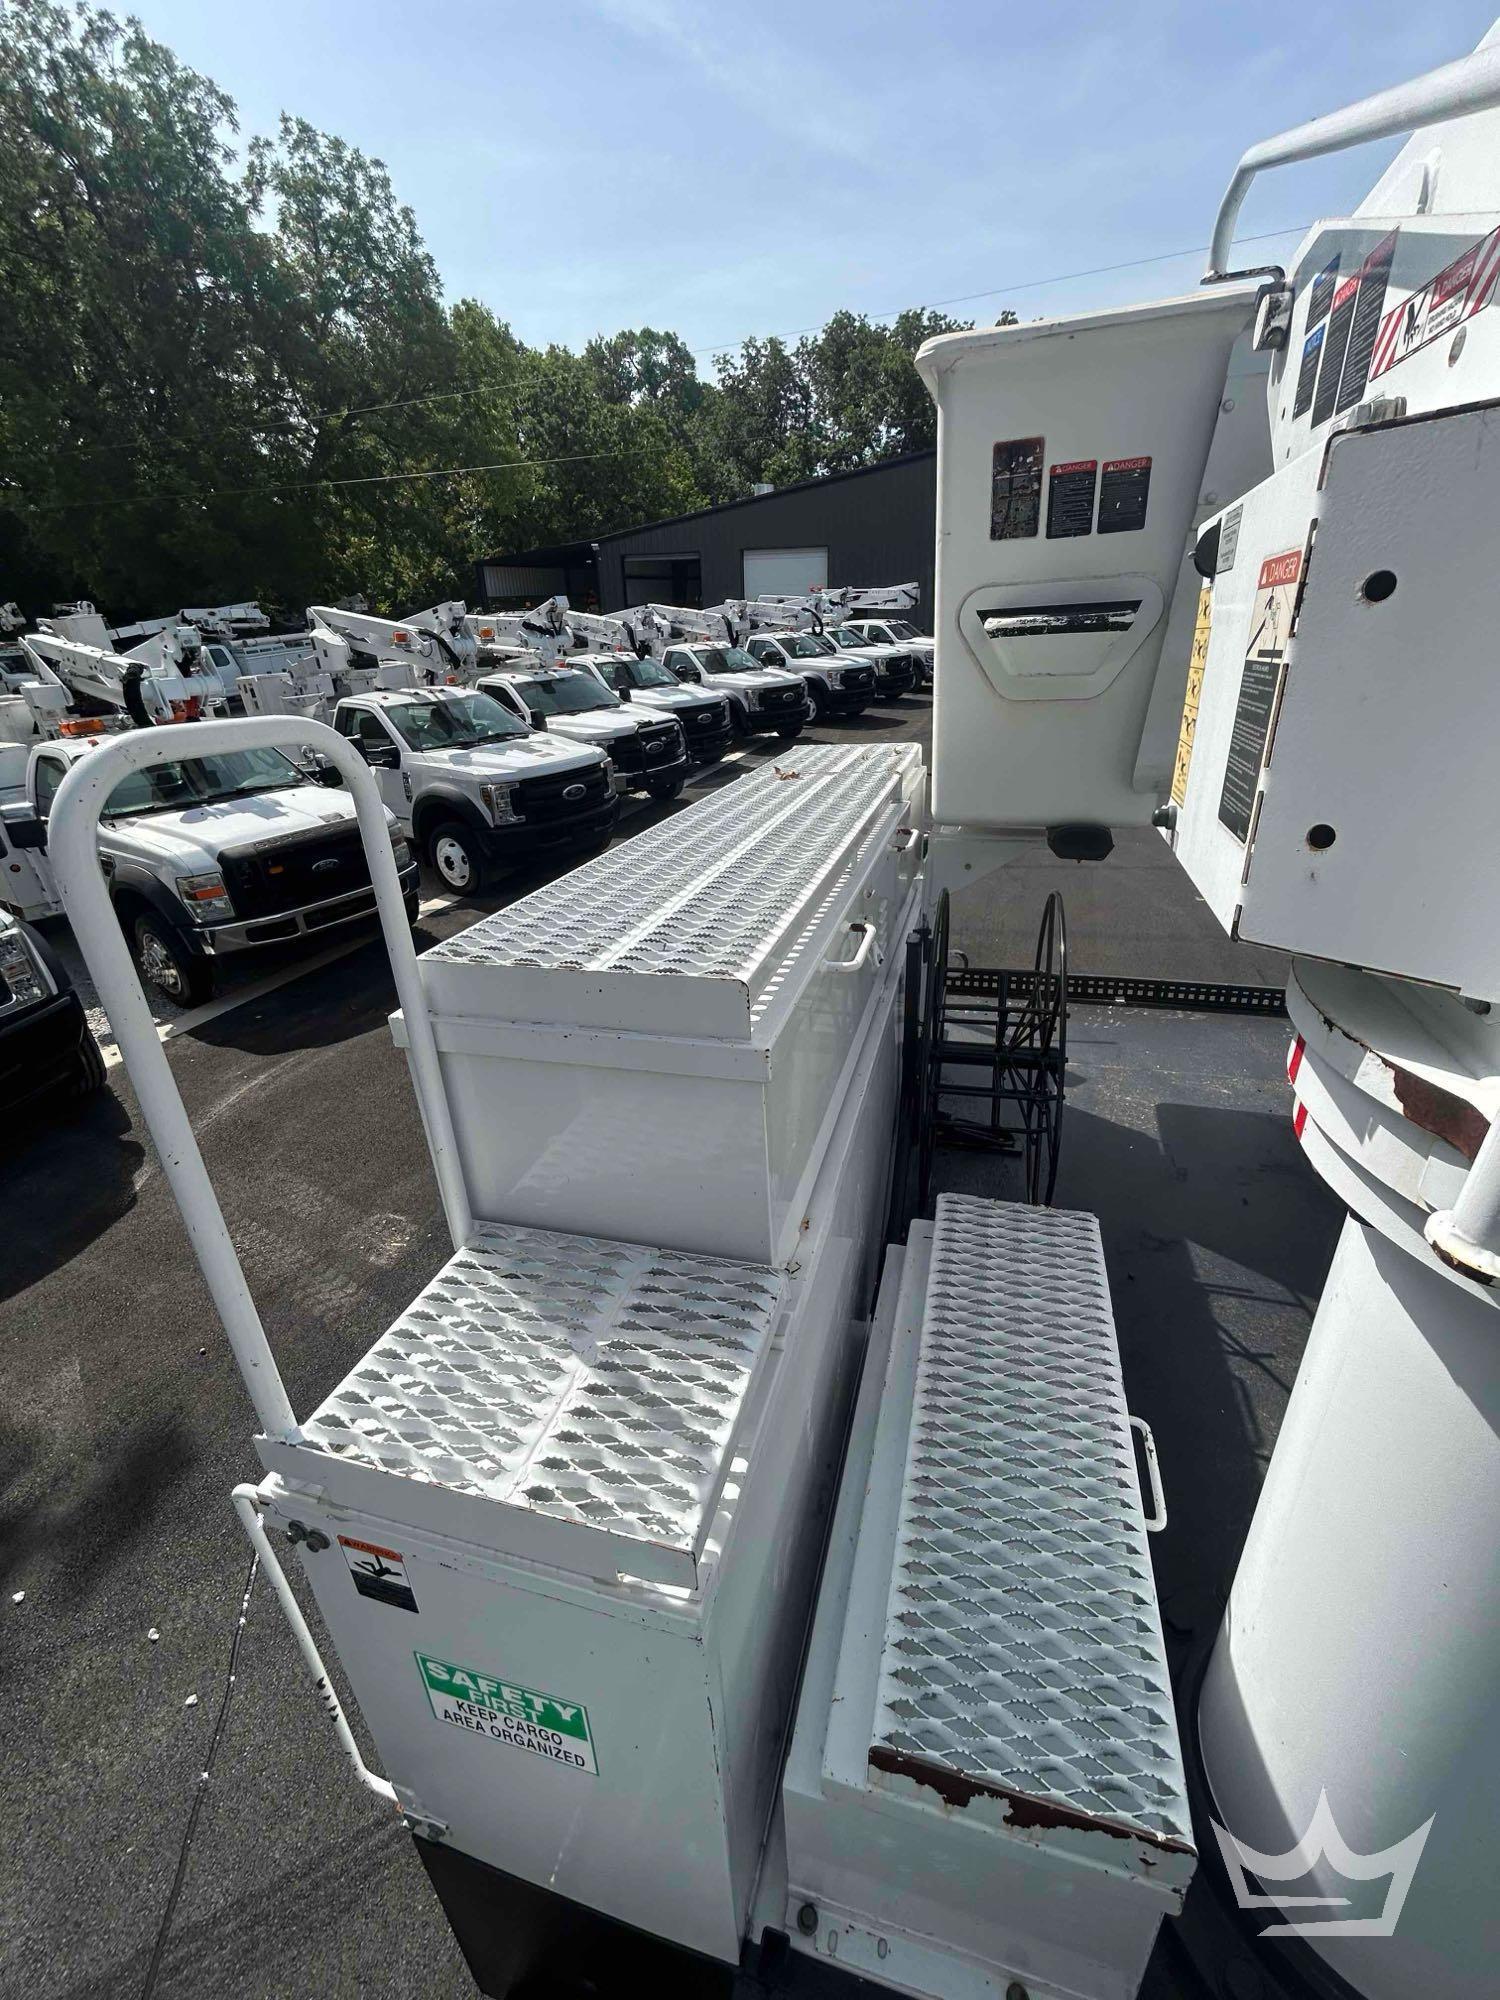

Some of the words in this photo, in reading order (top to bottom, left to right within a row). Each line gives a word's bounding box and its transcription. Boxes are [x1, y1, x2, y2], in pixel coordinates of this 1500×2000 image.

[1062, 462, 1092, 473] DANGER
[1114, 458, 1148, 471] DANGER
[1269, 557, 1298, 583] DANGER
[426, 1660, 578, 1722] SAFETY
[468, 1688, 542, 1724] FIRST
[443, 1709, 486, 1733] AREA
[490, 1726, 586, 1768] ORGANIZED
[456, 1699, 498, 1723] KEEP
[503, 1716, 563, 1746] CARGO
